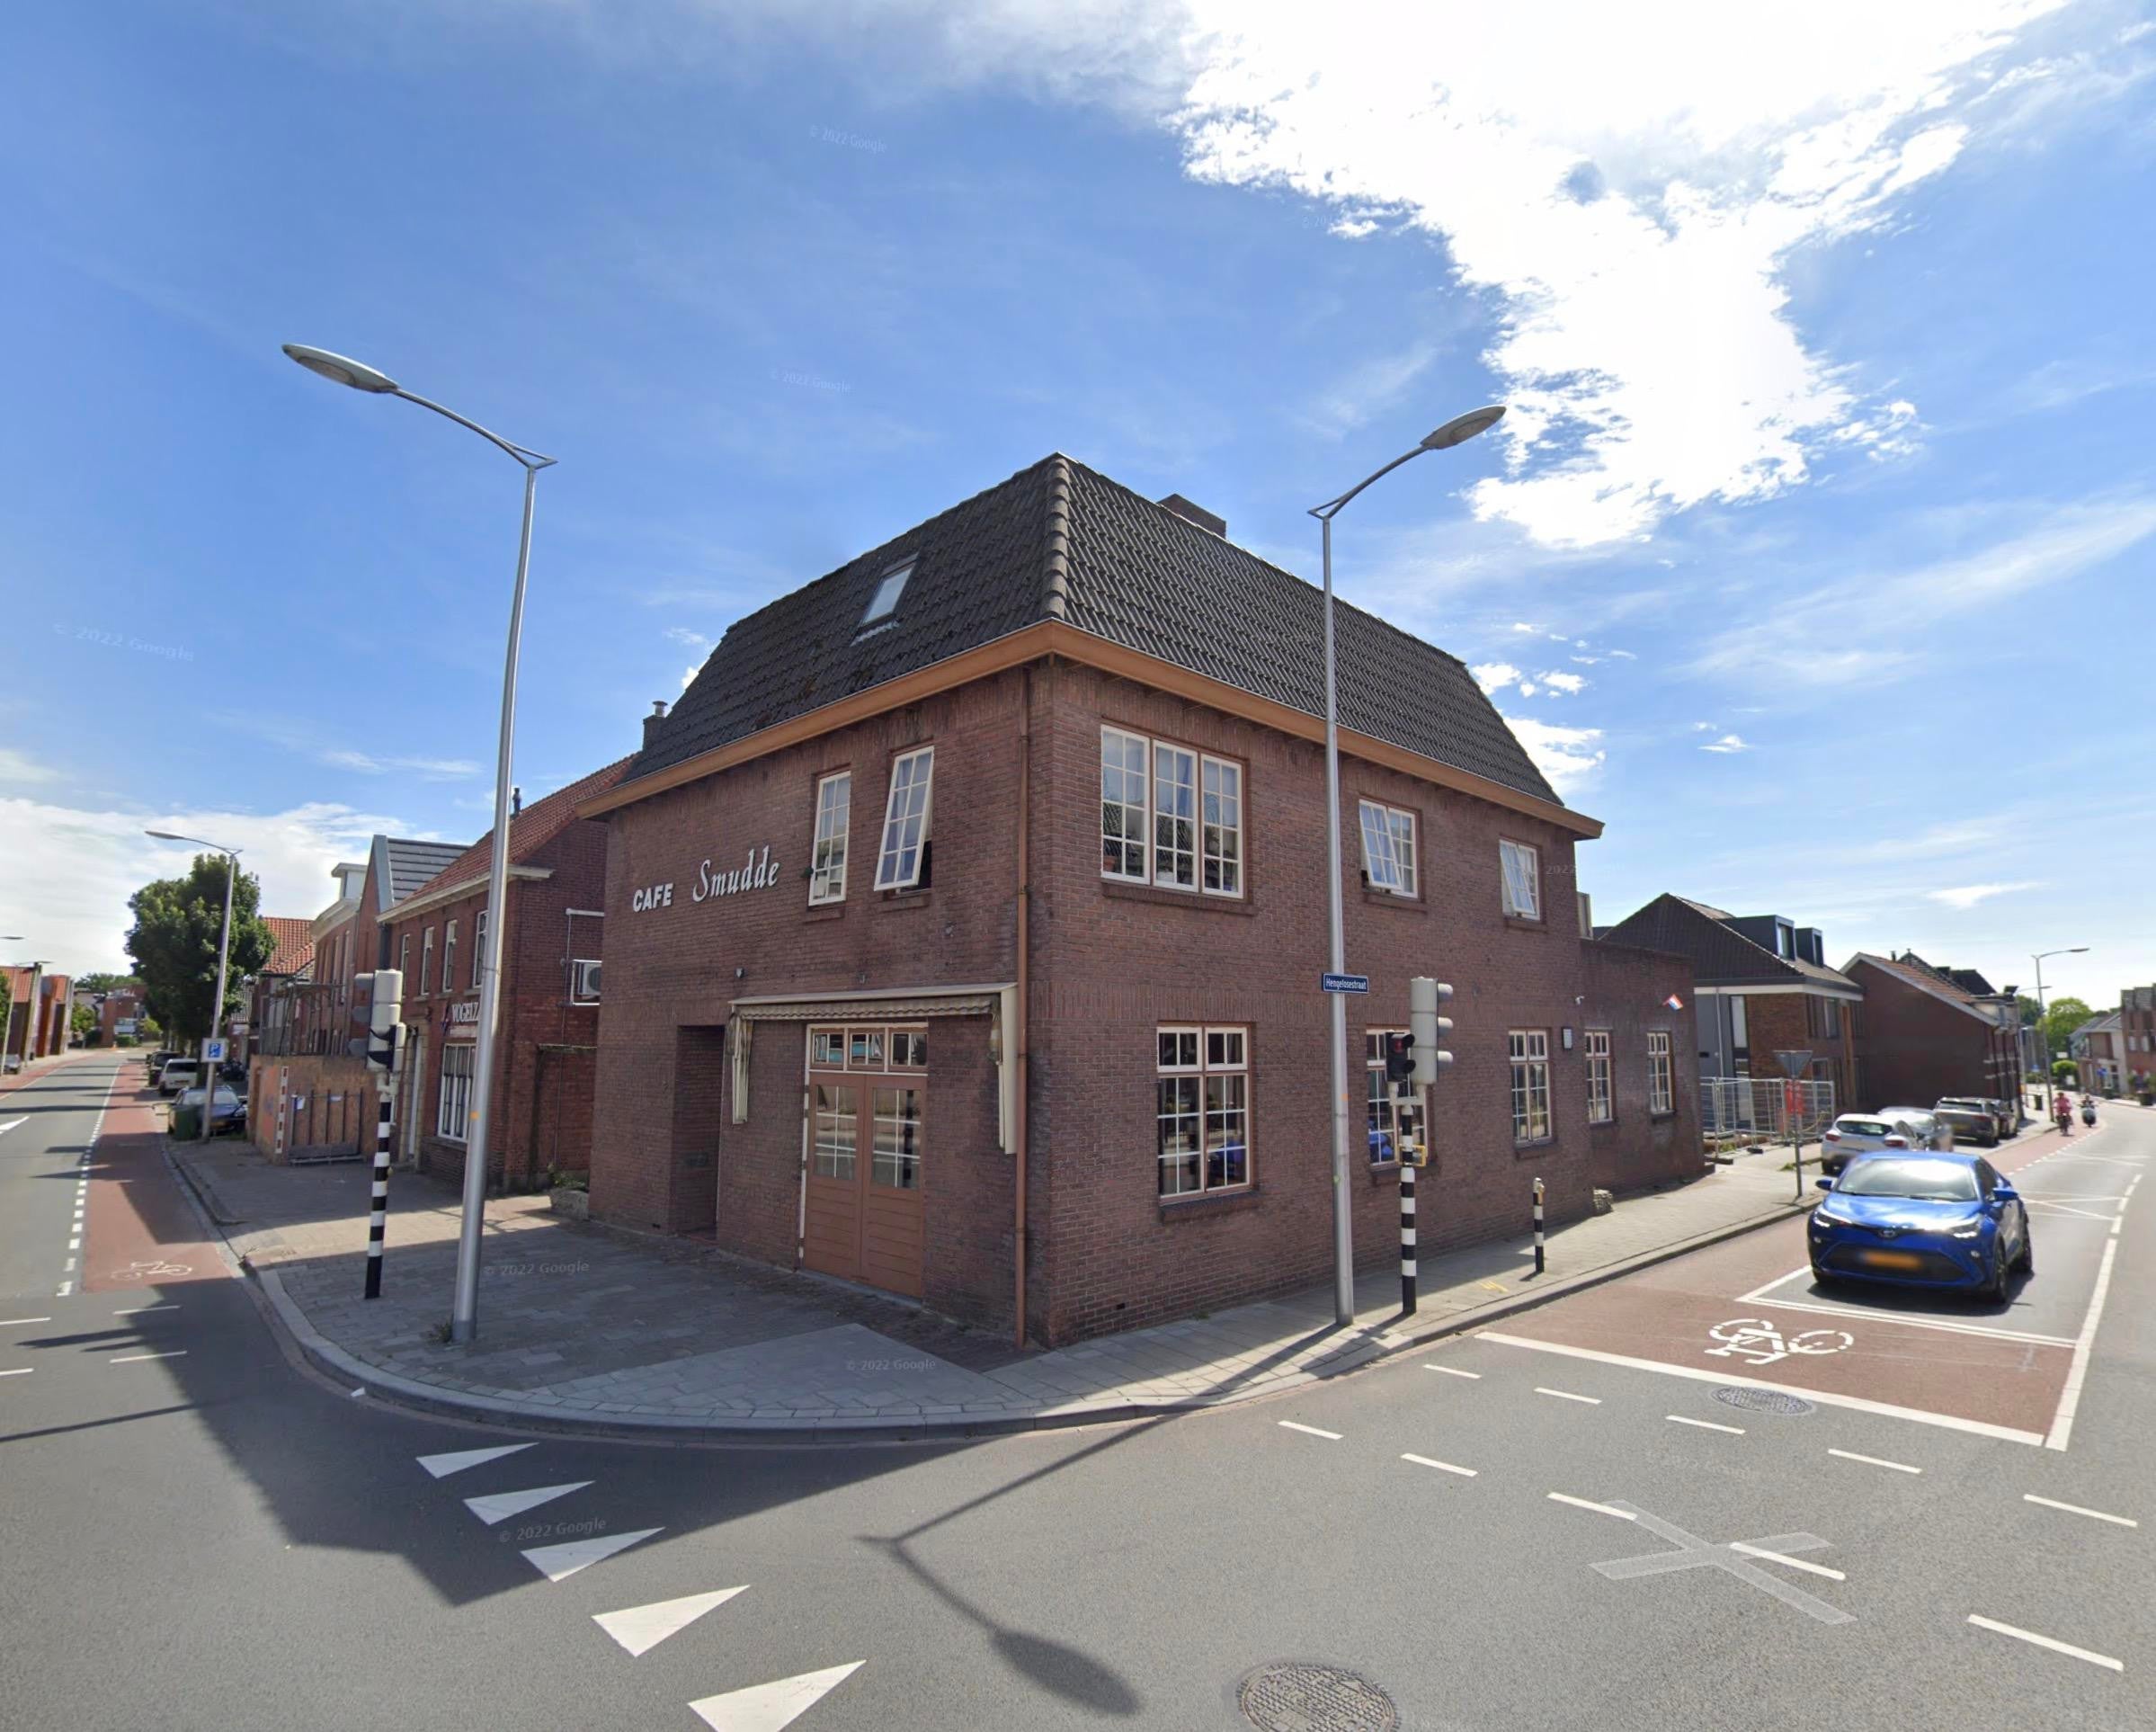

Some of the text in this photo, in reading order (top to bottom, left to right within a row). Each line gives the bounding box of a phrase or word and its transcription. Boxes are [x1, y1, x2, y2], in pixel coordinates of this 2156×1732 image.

[633, 845, 780, 913] CAFE Smudde
[1326, 978, 1367, 989] Hengelosestraat
